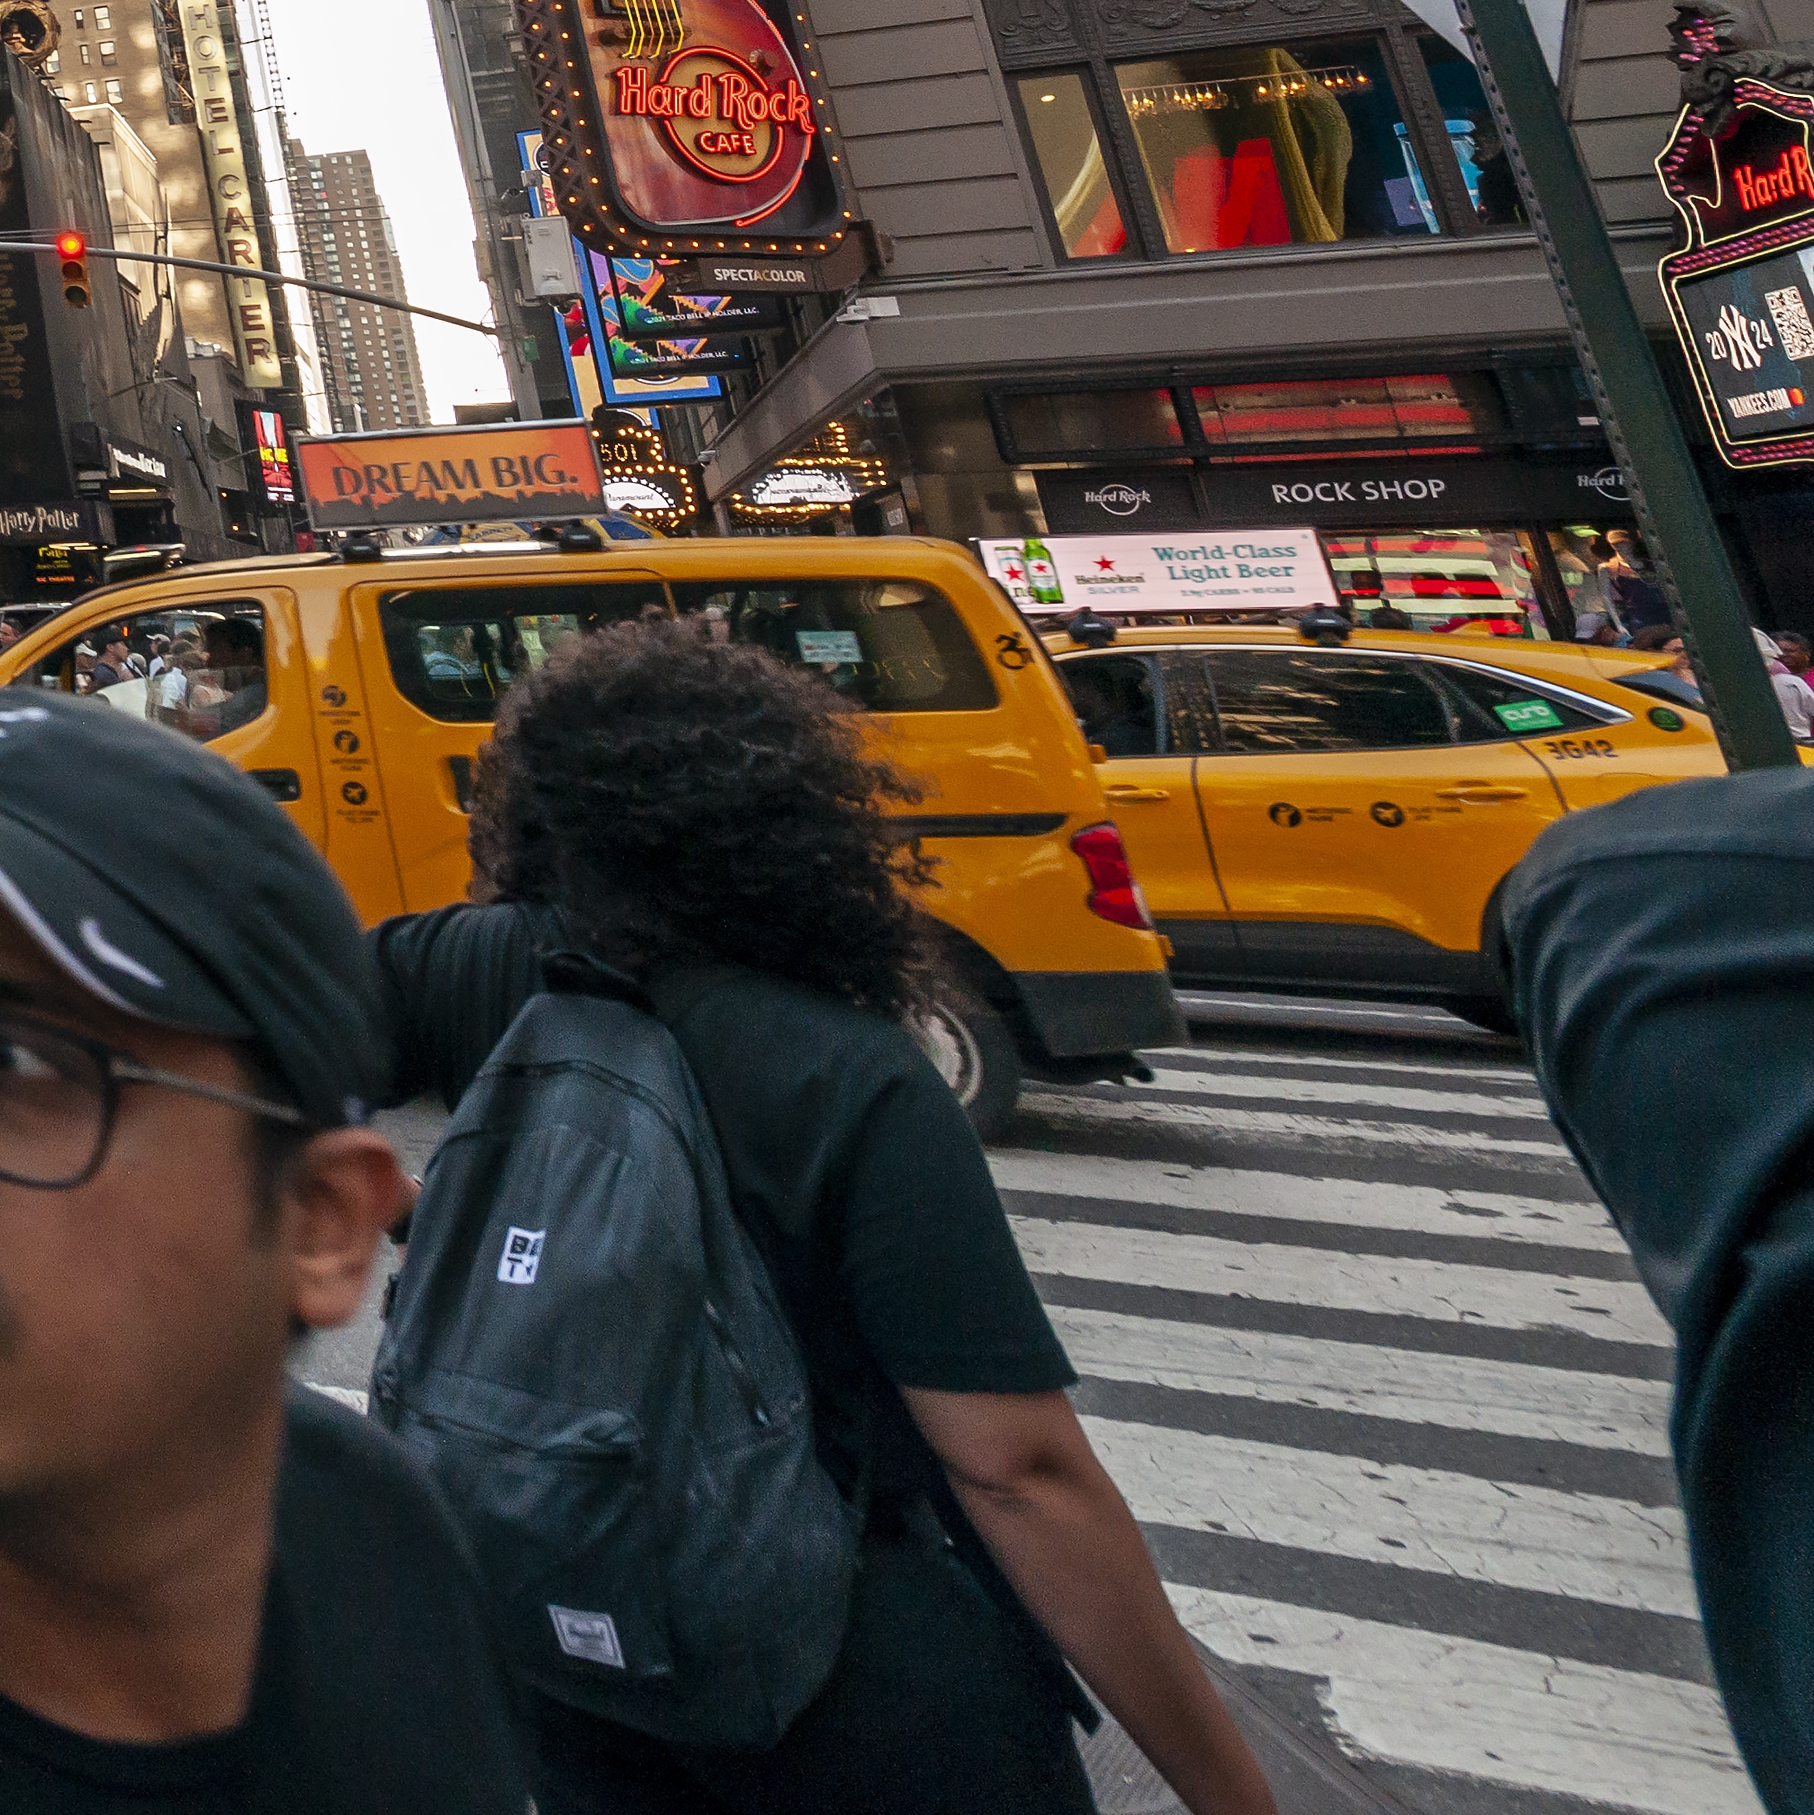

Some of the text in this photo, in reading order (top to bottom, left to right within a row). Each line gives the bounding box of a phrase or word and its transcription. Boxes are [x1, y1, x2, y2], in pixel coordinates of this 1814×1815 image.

[187, 4, 234, 156] HOTEL
[616, 65, 816, 136] Hard Rock
[699, 131, 758, 157] CAFE
[1733, 150, 1797, 212] Hard
[713, 268, 807, 283] SPECTACOLOR
[1705, 331, 1728, 361] 20
[1750, 317, 1774, 350] 24
[332, 452, 579, 498] DREAM BIG.
[1084, 489, 1151, 504] Hard Rock
[1272, 479, 1446, 505] ROCK SHOP
[35, 506, 80, 534] Potter
[1150, 544, 1298, 563] World-Class
[1074, 572, 1144, 586] Heineken
[1167, 563, 1295, 583] Light Beer
